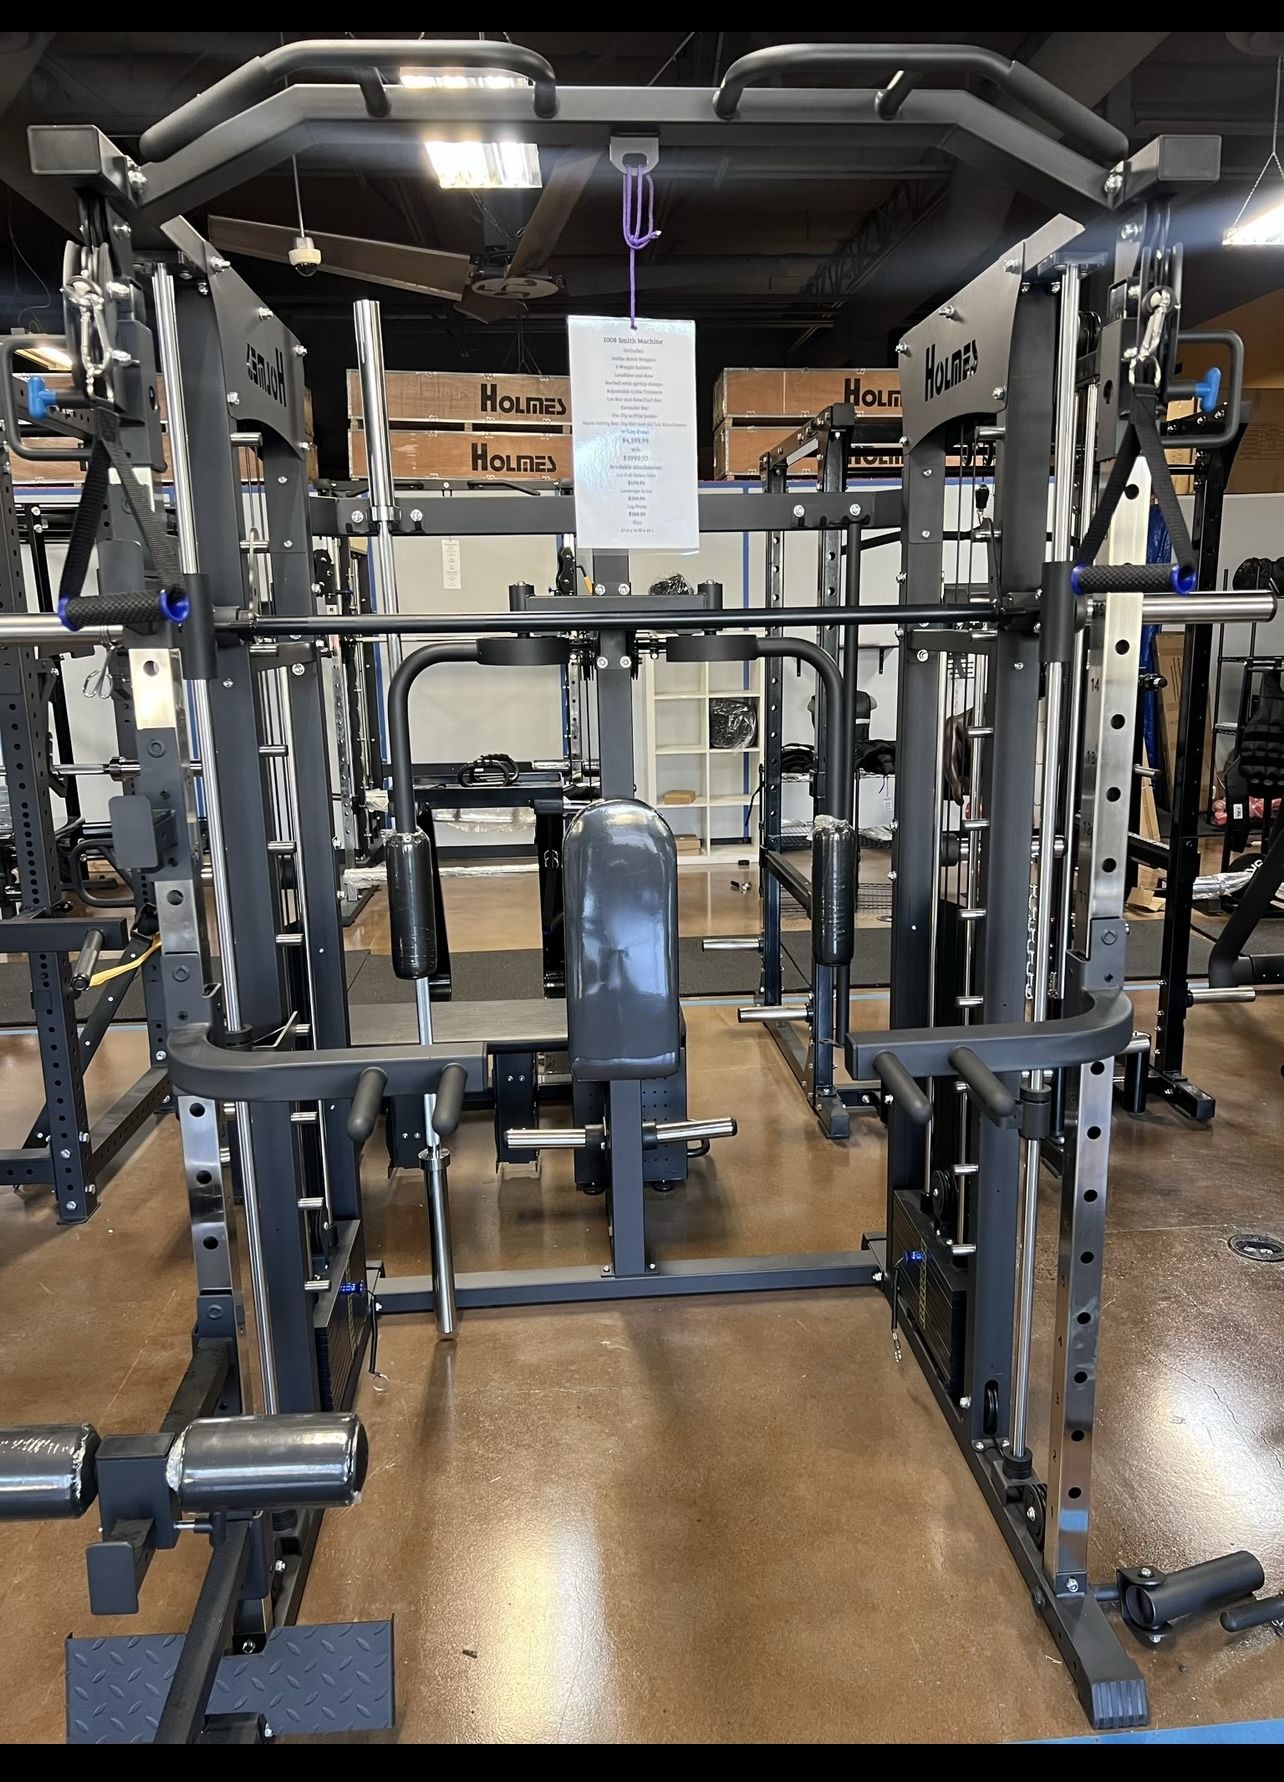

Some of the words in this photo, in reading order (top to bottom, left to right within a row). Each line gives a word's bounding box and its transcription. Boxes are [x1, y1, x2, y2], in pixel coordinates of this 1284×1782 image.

[618, 336, 636, 344] Smith
[925, 339, 978, 402] HOLMES
[481, 383, 567, 415] HOLMES
[844, 378, 902, 407] HOLM
[471, 443, 557, 472] HOLMES
[1090, 678, 1100, 693] 14
